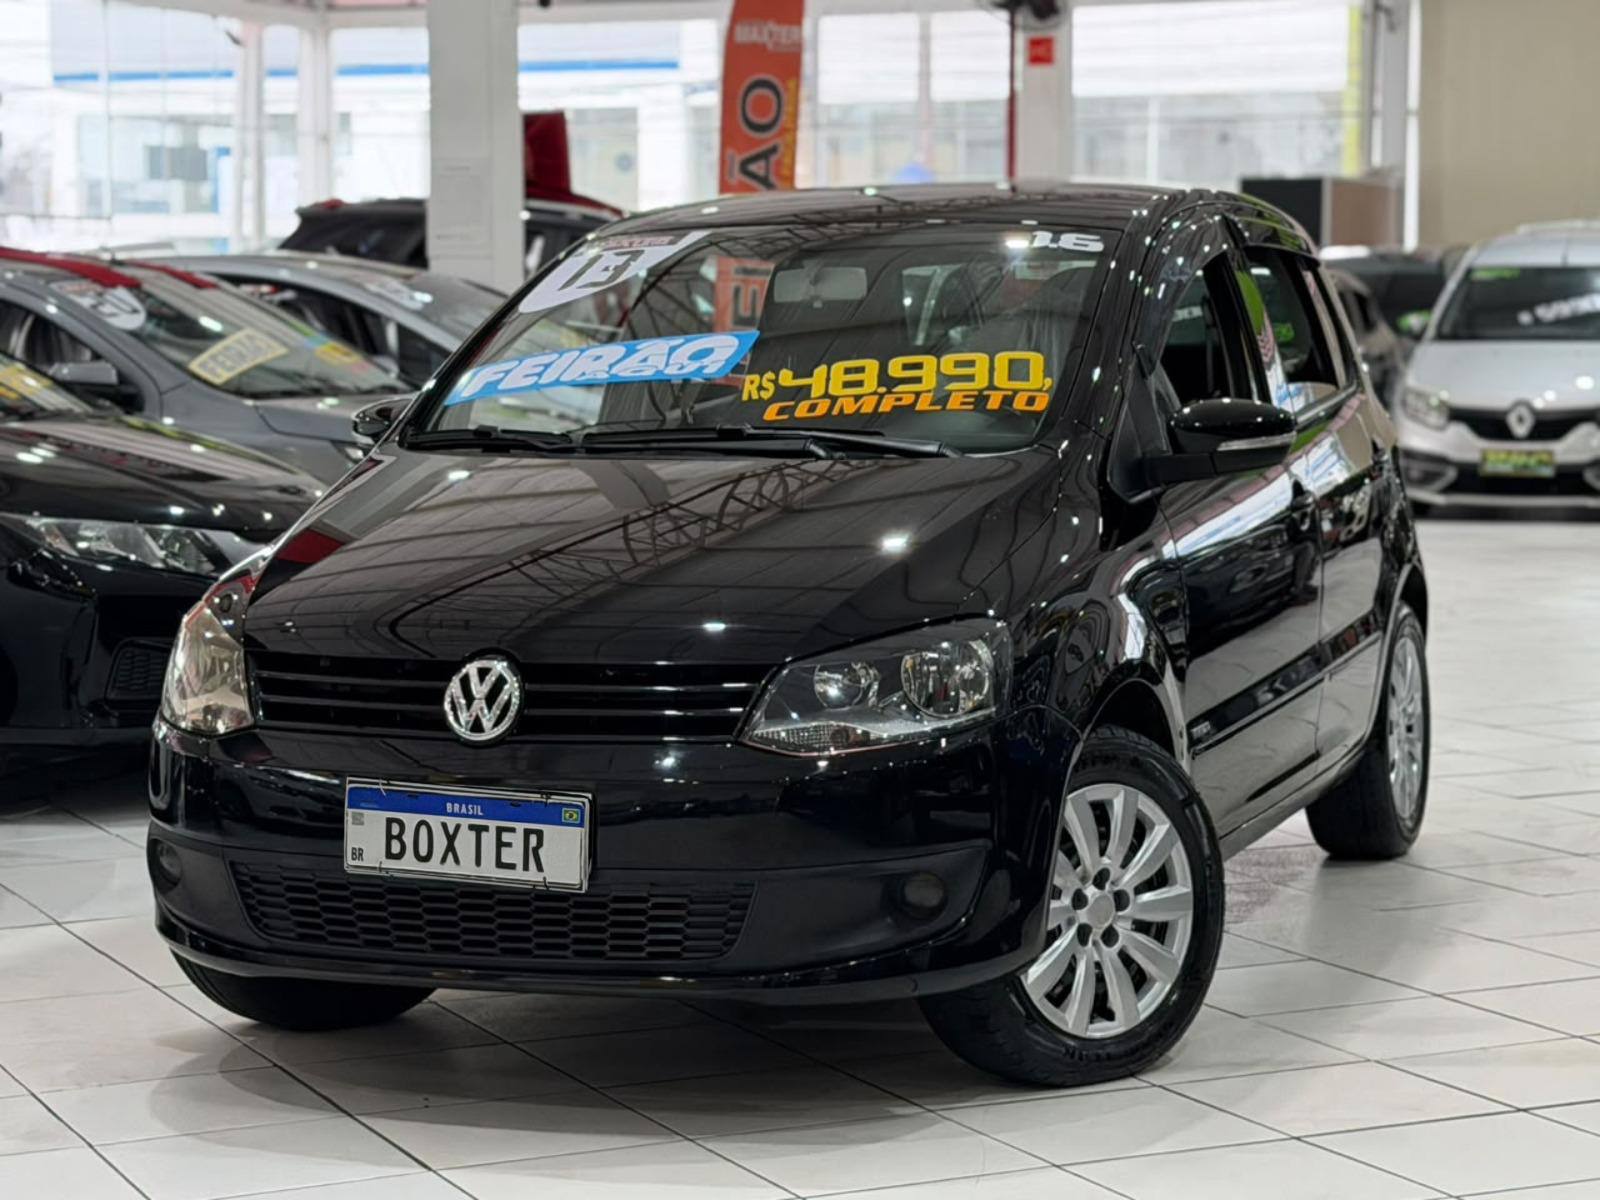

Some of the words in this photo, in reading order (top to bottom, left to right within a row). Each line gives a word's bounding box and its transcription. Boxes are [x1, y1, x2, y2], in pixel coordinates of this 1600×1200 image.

[460, 334, 740, 398] FEIRÃO
[762, 390, 1050, 421] COMPLETO
[444, 659, 521, 741] VW
[445, 801, 484, 817] BRASIL
[350, 846, 365, 862] BR
[384, 816, 545, 874] BOXTER
